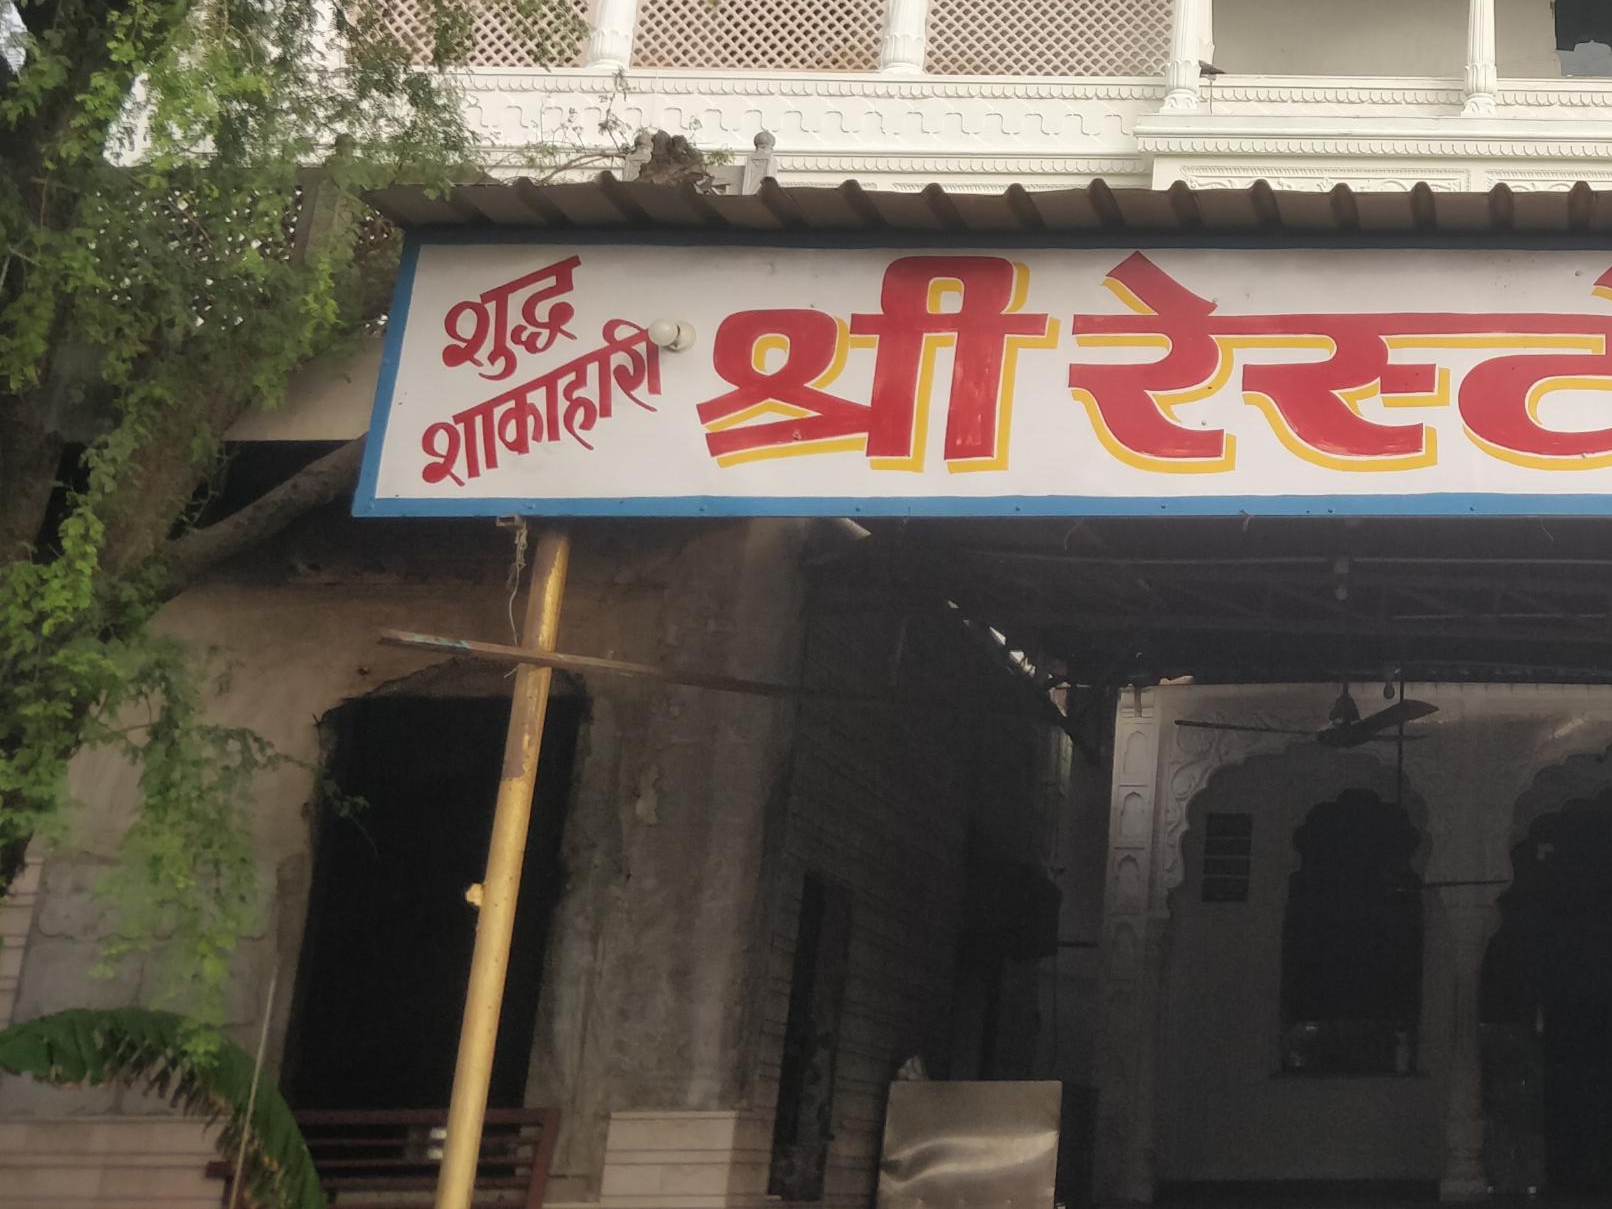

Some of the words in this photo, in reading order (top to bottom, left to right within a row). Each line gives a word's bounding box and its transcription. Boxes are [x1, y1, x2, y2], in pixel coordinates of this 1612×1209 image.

[442, 255, 582, 380] शुद्ध
[696, 255, 1058, 474] श्री
[421, 318, 662, 487] शाकाहारी
